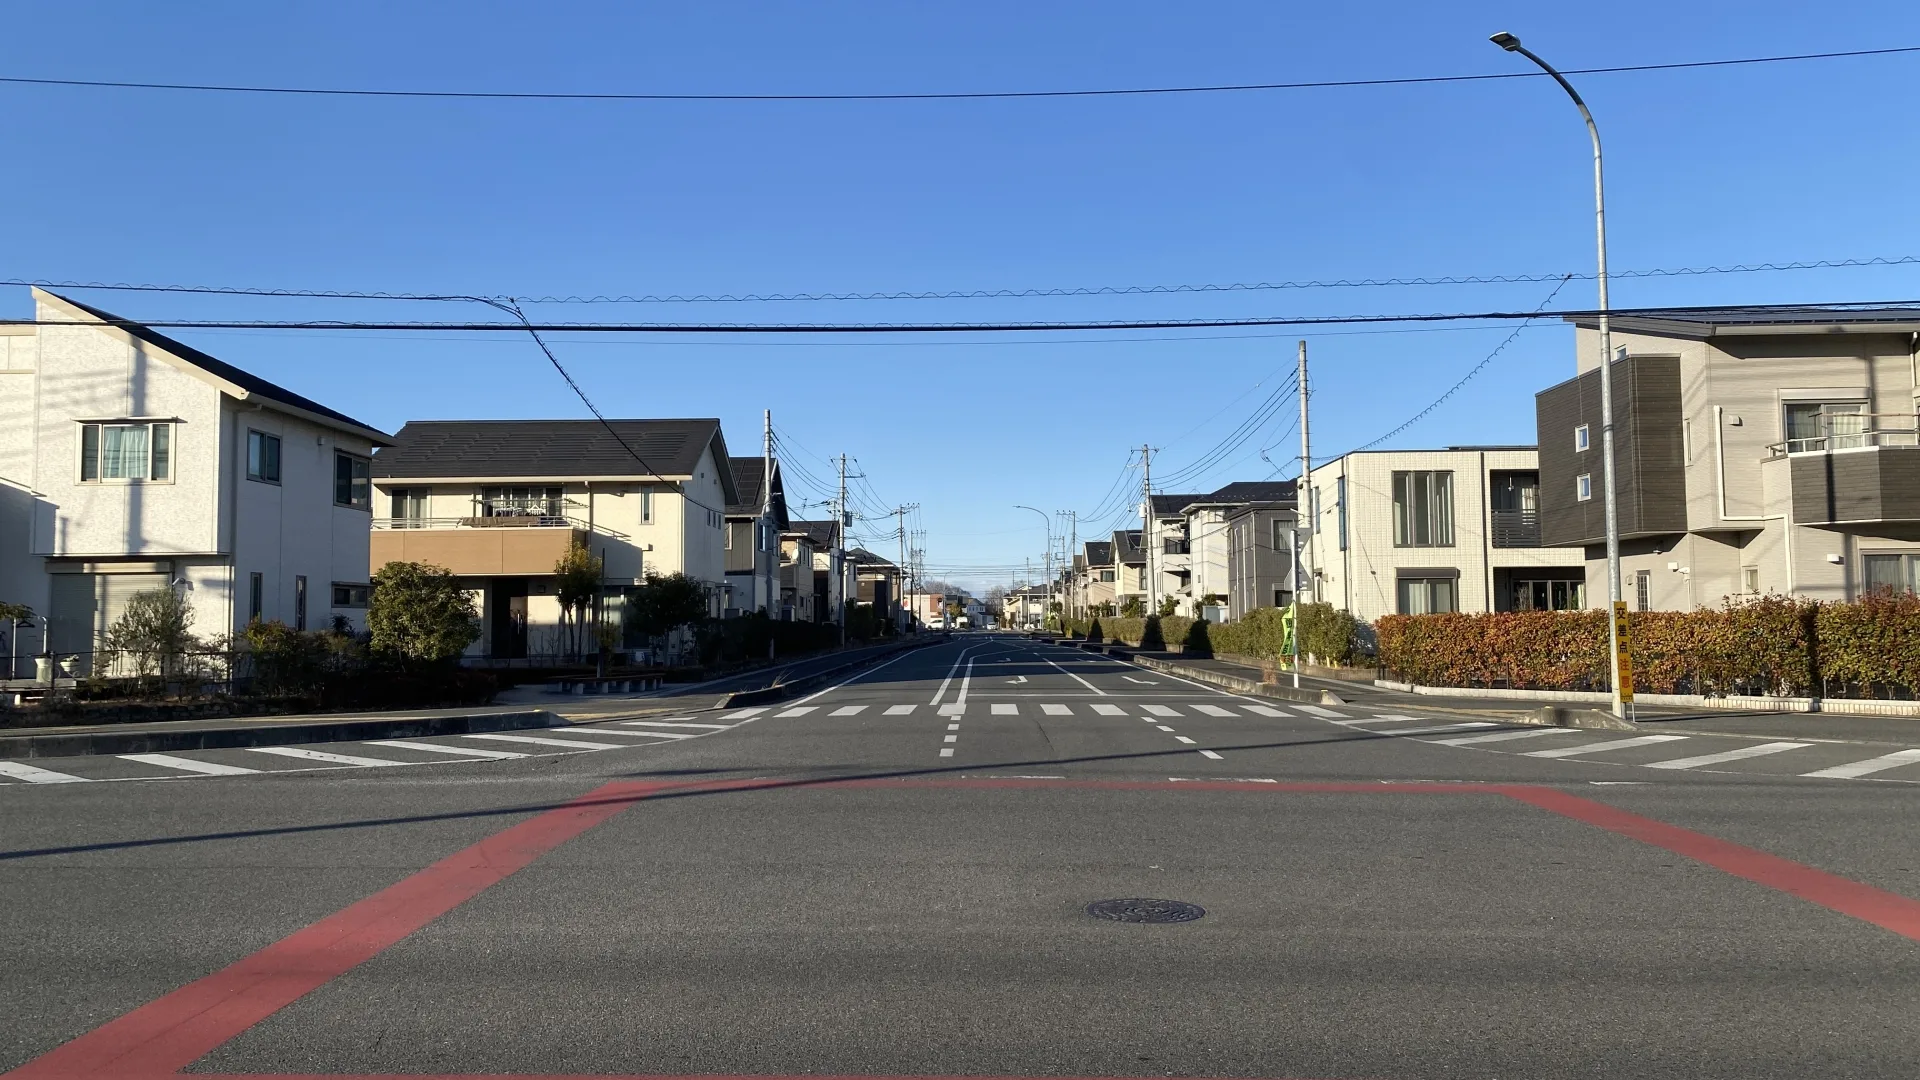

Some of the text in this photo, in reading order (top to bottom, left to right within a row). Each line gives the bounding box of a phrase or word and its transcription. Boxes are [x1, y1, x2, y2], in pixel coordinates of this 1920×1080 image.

[1616, 606, 1630, 689] 交差点注意
